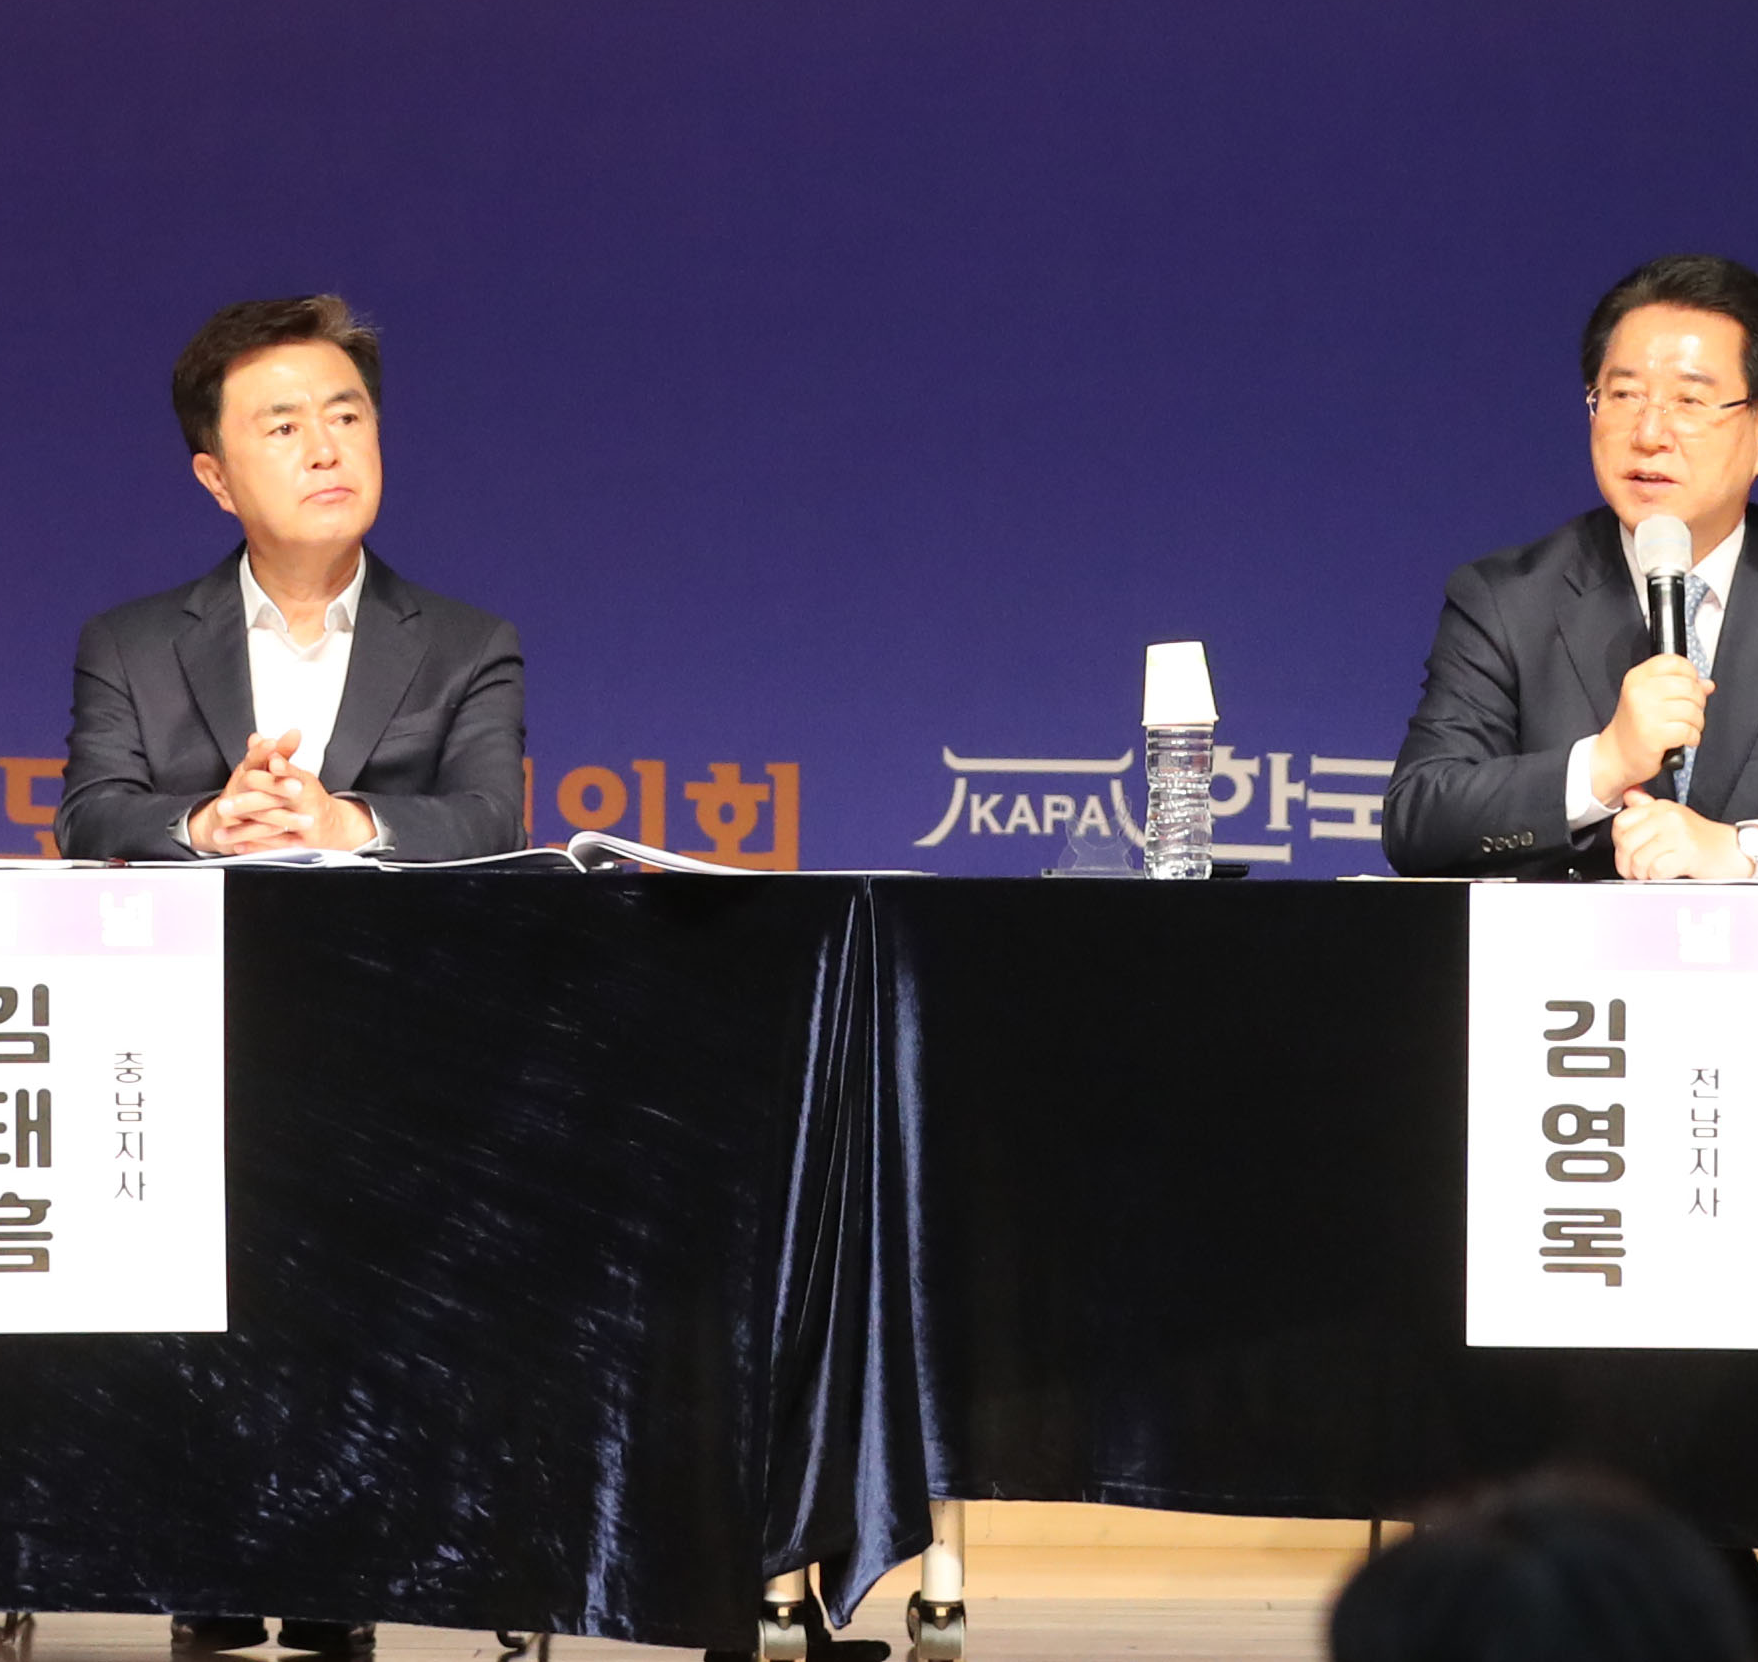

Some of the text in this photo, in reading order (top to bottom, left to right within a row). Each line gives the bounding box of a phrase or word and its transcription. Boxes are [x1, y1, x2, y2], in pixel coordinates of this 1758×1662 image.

[969, 795, 1112, 836] KAPA
[113, 1052, 146, 1201] 충남지사
[1688, 1068, 1721, 1218] 전남지사
